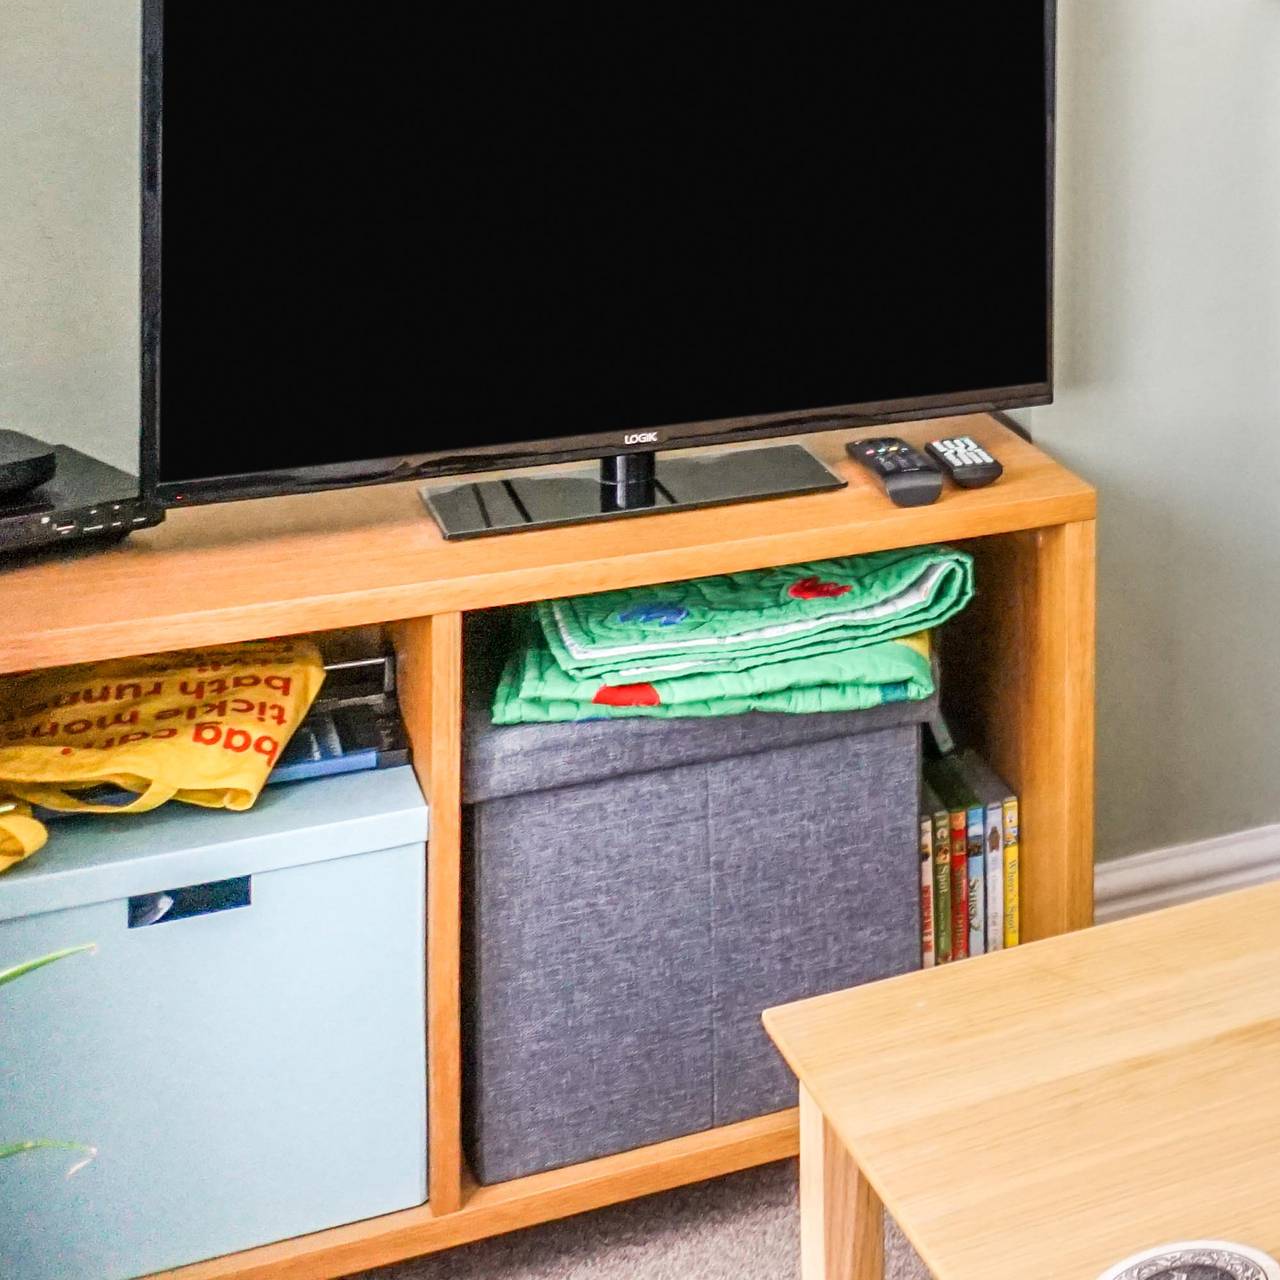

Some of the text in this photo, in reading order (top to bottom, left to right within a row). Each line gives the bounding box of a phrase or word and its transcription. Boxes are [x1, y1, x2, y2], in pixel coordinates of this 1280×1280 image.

[624, 432, 658, 445] LOGIK
[180, 673, 292, 701] bath
[154, 698, 287, 728] tickle
[191, 722, 280, 768] bag
[938, 864, 949, 893] Spot
